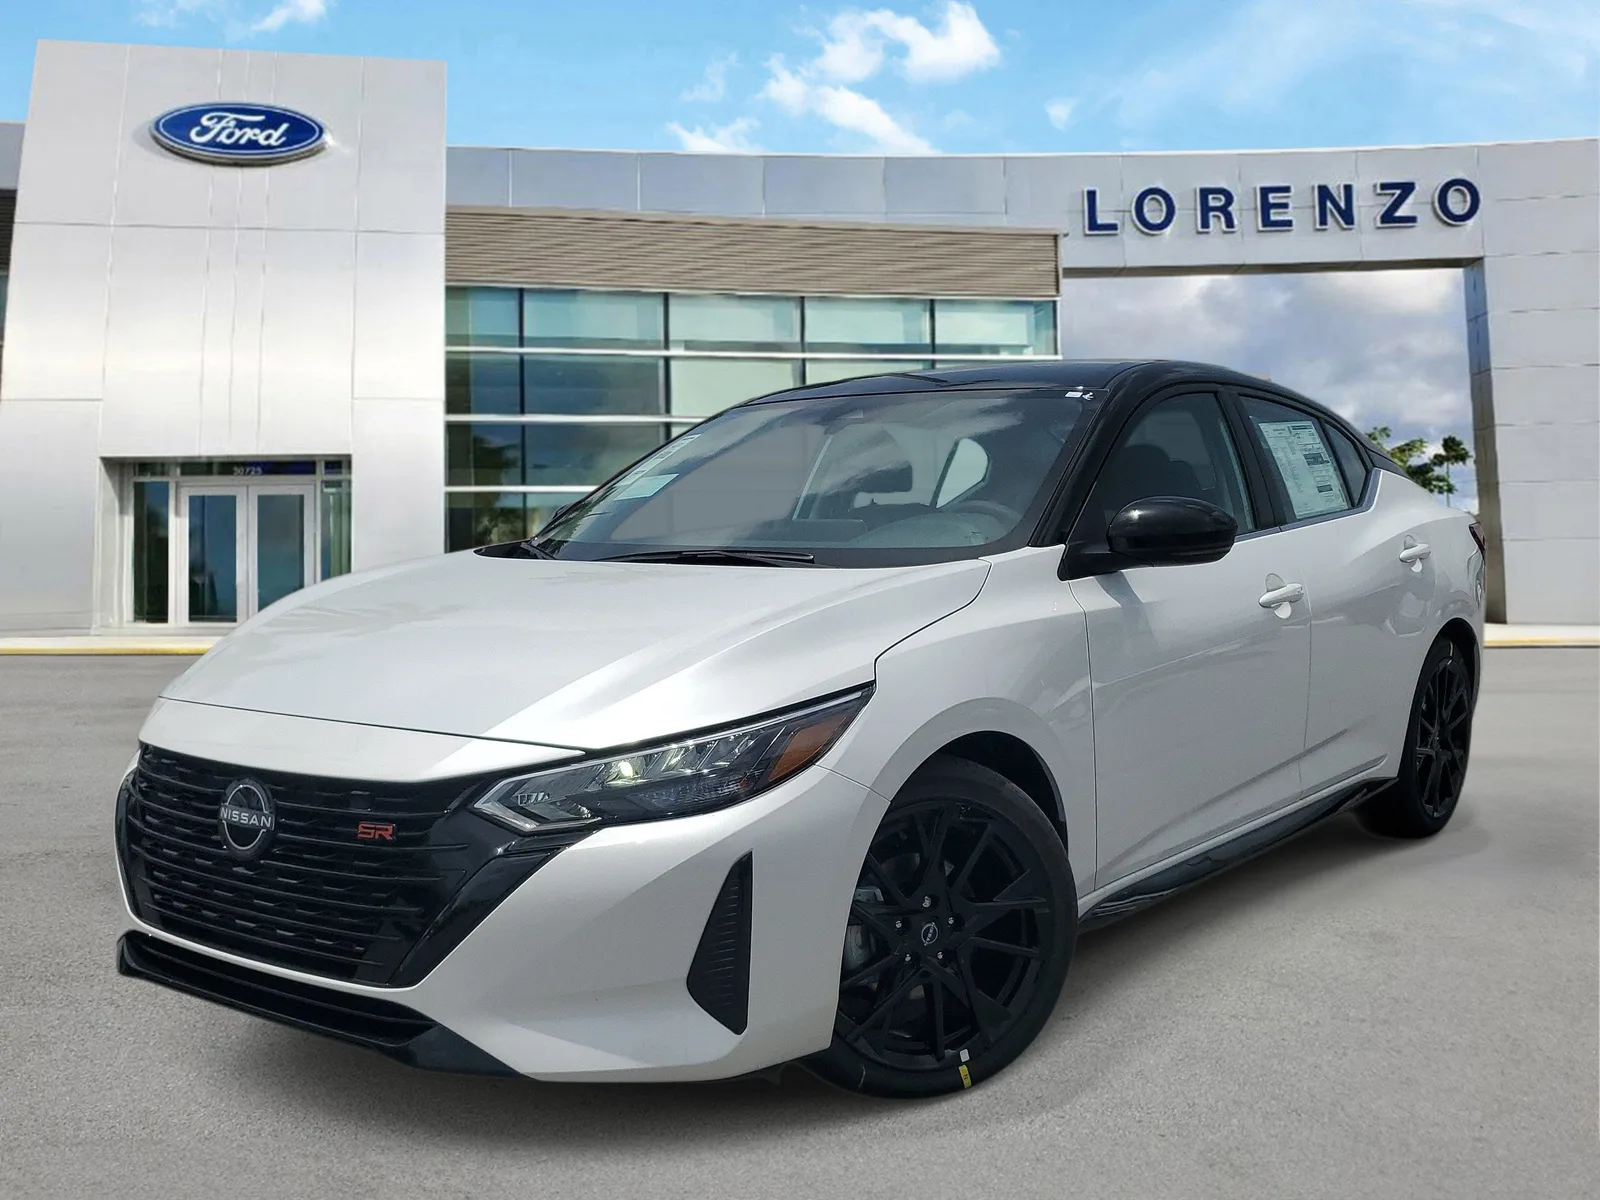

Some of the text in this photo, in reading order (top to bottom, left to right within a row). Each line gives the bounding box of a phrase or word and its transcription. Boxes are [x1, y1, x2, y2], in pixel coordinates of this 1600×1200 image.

[189, 111, 290, 147] Ford
[1082, 178, 1482, 236] LORENZO
[220, 807, 271, 829] NISSAN
[358, 821, 395, 840] SR
